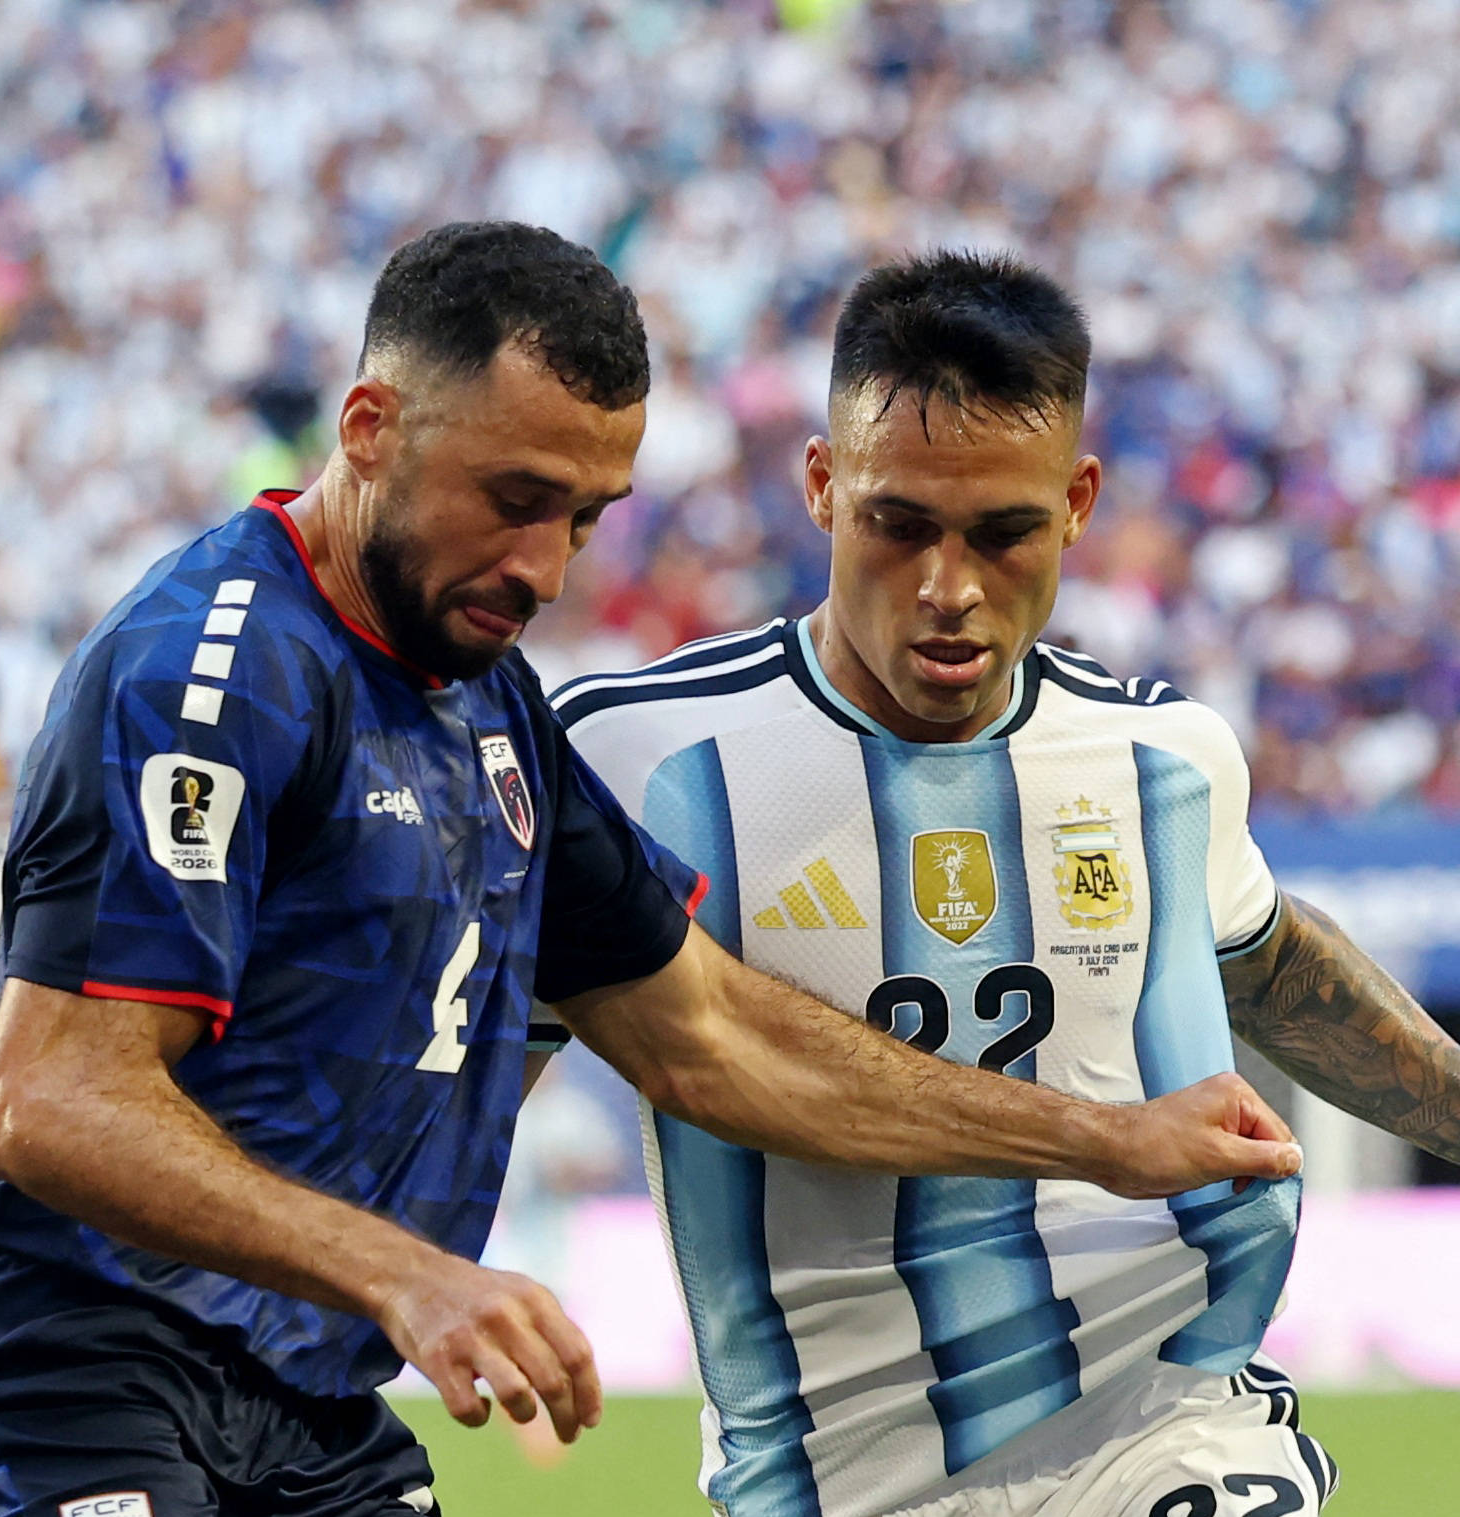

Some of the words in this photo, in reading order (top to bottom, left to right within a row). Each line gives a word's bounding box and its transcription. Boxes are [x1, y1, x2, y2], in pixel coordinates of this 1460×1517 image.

[480, 742, 508, 762] FCF
[182, 828, 207, 840] FIFA
[171, 849, 201, 857] WORLD
[171, 858, 218, 869] 2026
[1073, 852, 1120, 902] AFA
[937, 901, 977, 916] FIFA
[946, 921, 970, 931] 2022
[1050, 945, 1091, 955] ARGENTINA
[1085, 956, 1101, 966] JULY
[1102, 955, 1119, 965] 2026
